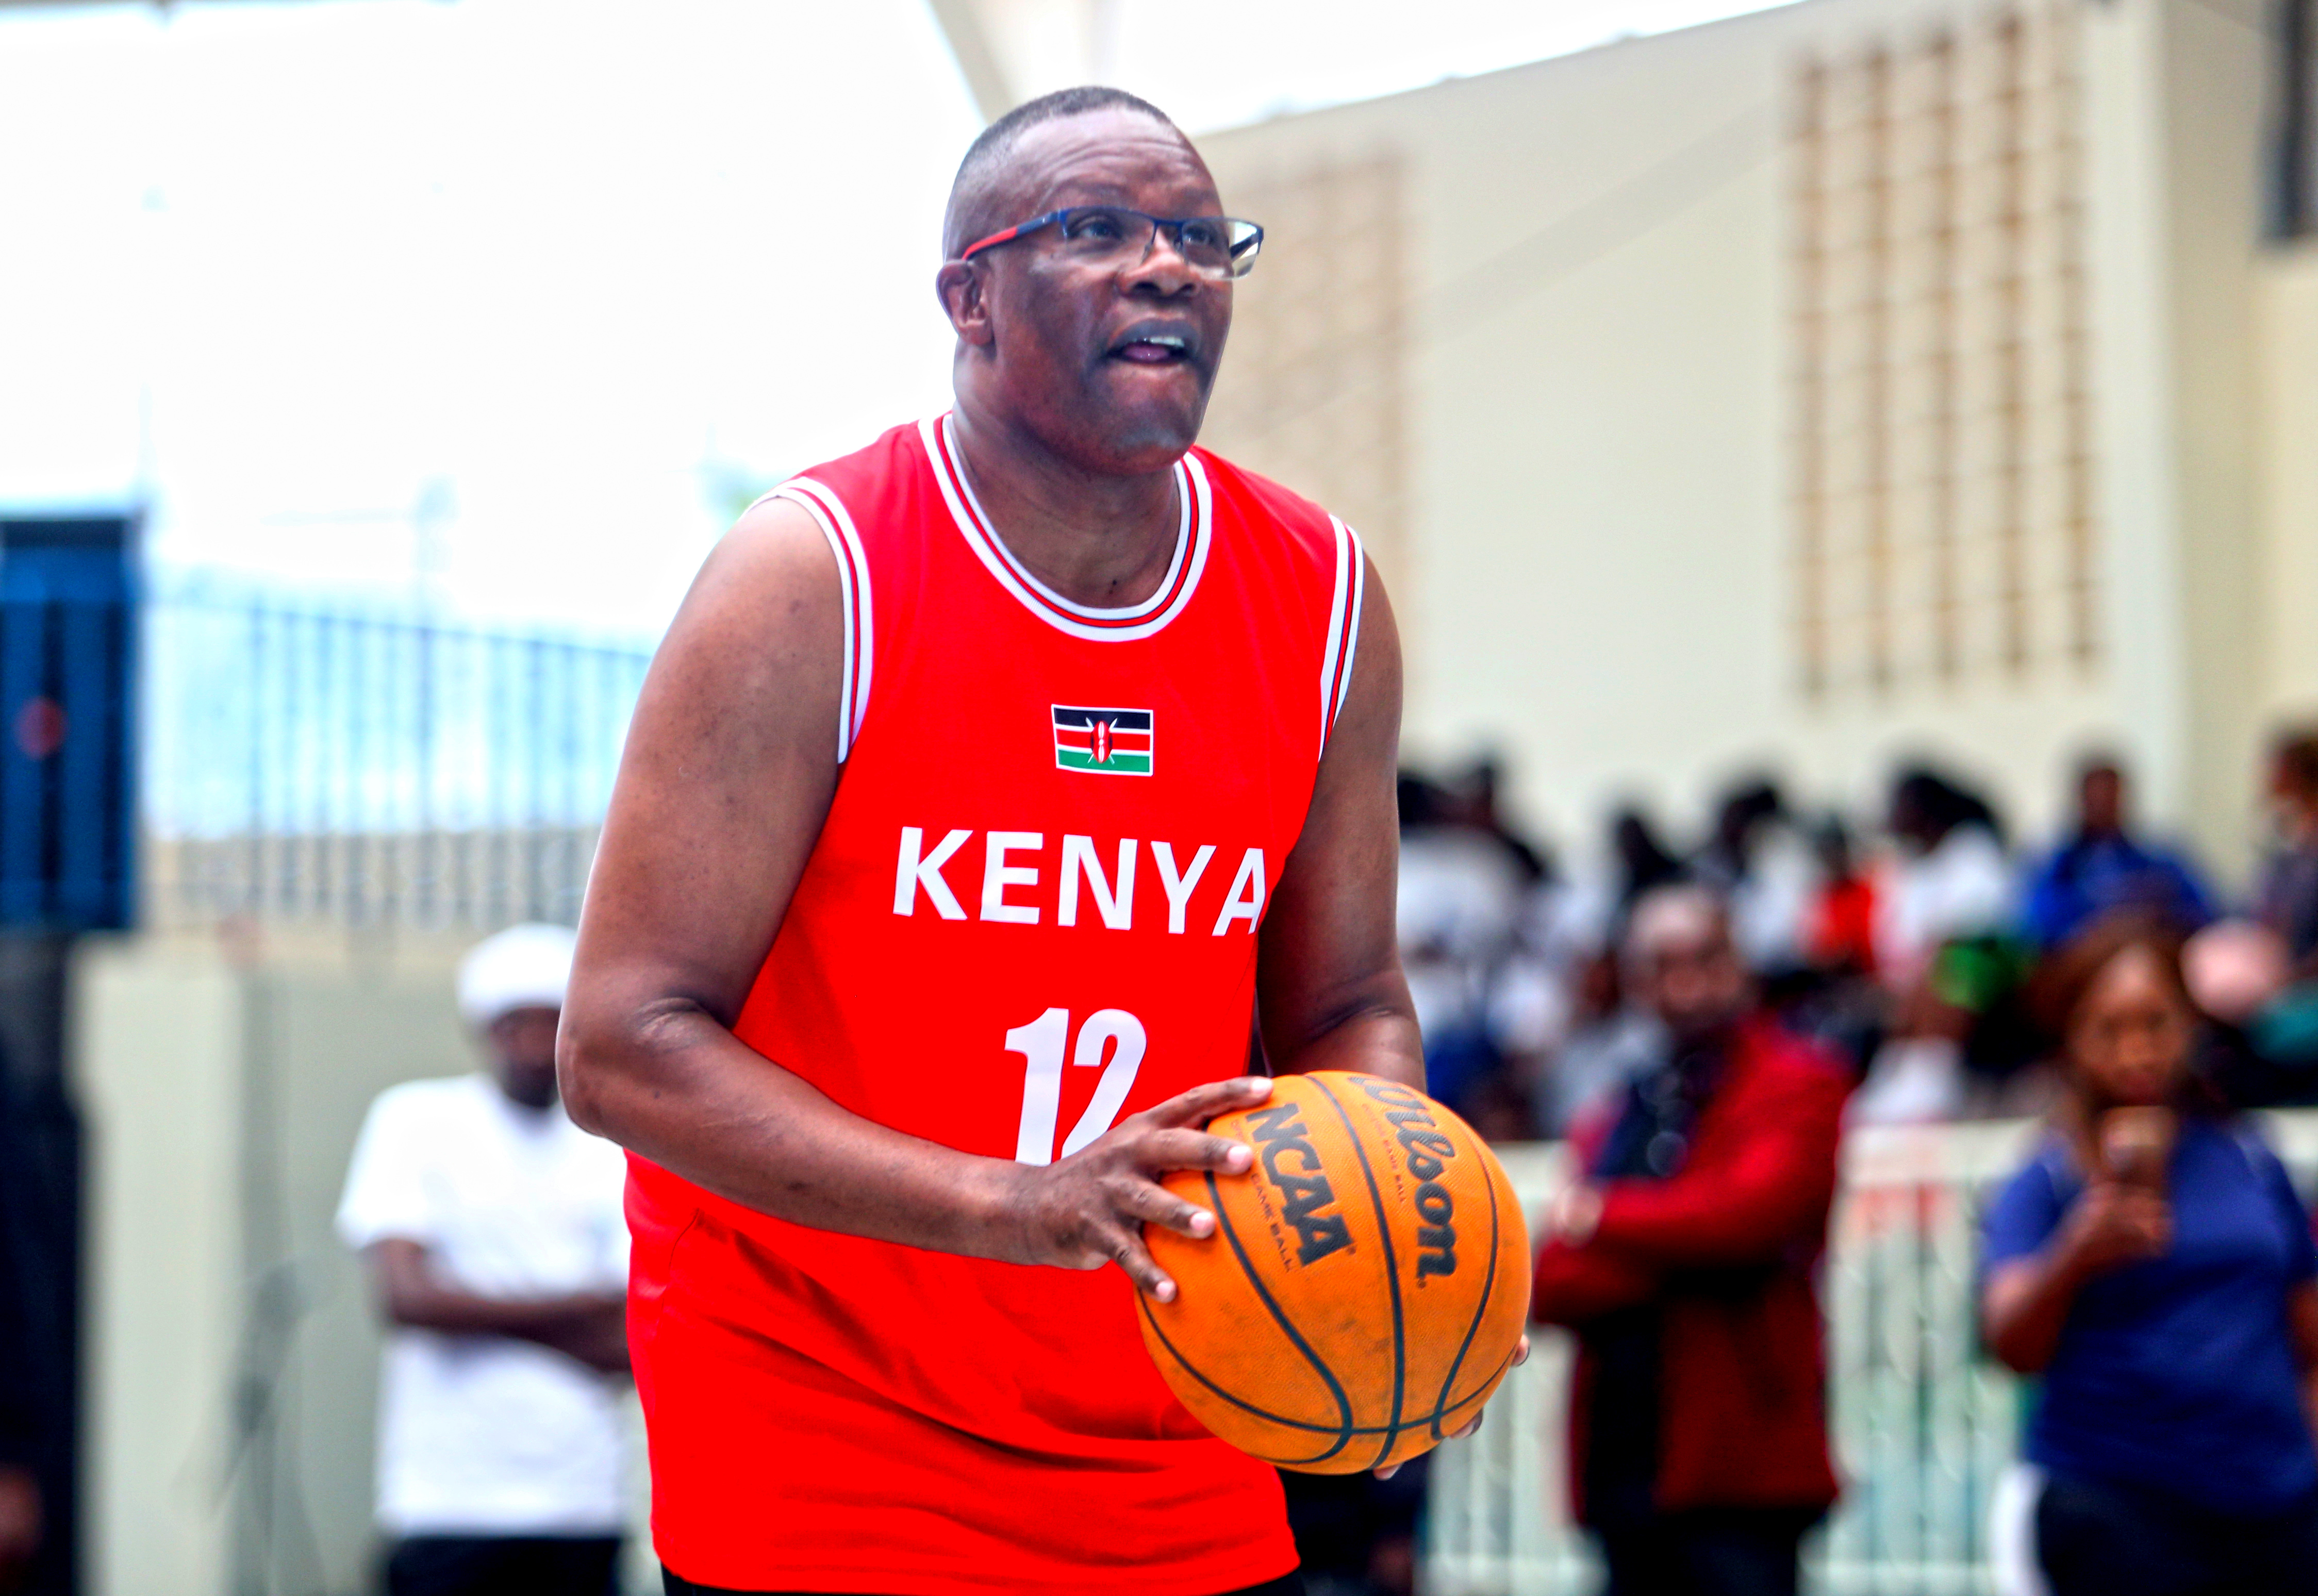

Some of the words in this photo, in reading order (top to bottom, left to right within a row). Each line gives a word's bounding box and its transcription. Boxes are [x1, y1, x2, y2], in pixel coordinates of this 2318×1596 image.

[893, 826, 1266, 937] KENYA
[1004, 1007, 1147, 1167] 12
[1245, 1103, 1353, 1267] NCAA
[1251, 1173, 1273, 1221] GAME
[1270, 1223, 1292, 1272] BALL
